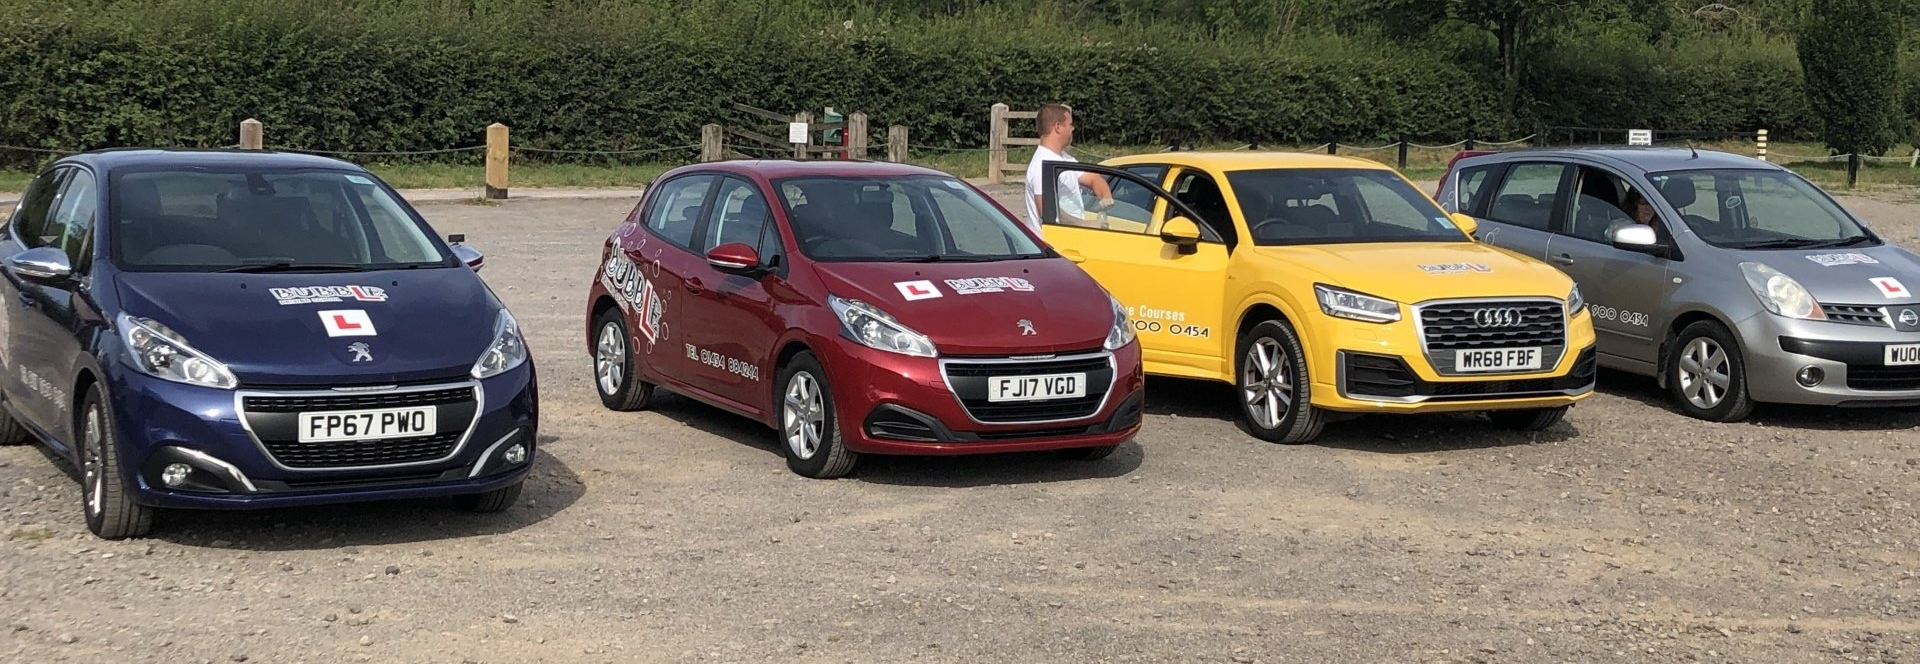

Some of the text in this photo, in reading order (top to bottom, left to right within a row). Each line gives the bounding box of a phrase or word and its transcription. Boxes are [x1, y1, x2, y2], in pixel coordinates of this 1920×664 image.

[269, 285, 389, 302] BUBBLE
[606, 237, 662, 345] BUBBLE
[907, 285, 930, 295] L
[1880, 281, 1901, 292] L
[333, 315, 362, 329] L
[1139, 304, 1186, 332] Courses
[1592, 305, 1649, 327] 900 0454
[1131, 319, 1210, 339] 00 0454
[686, 343, 759, 382] TEL 01454 884244
[1463, 350, 1535, 368] WR68 FBF
[1000, 377, 1075, 397] FJ17 VGD
[310, 410, 425, 438] FP67 PWO
